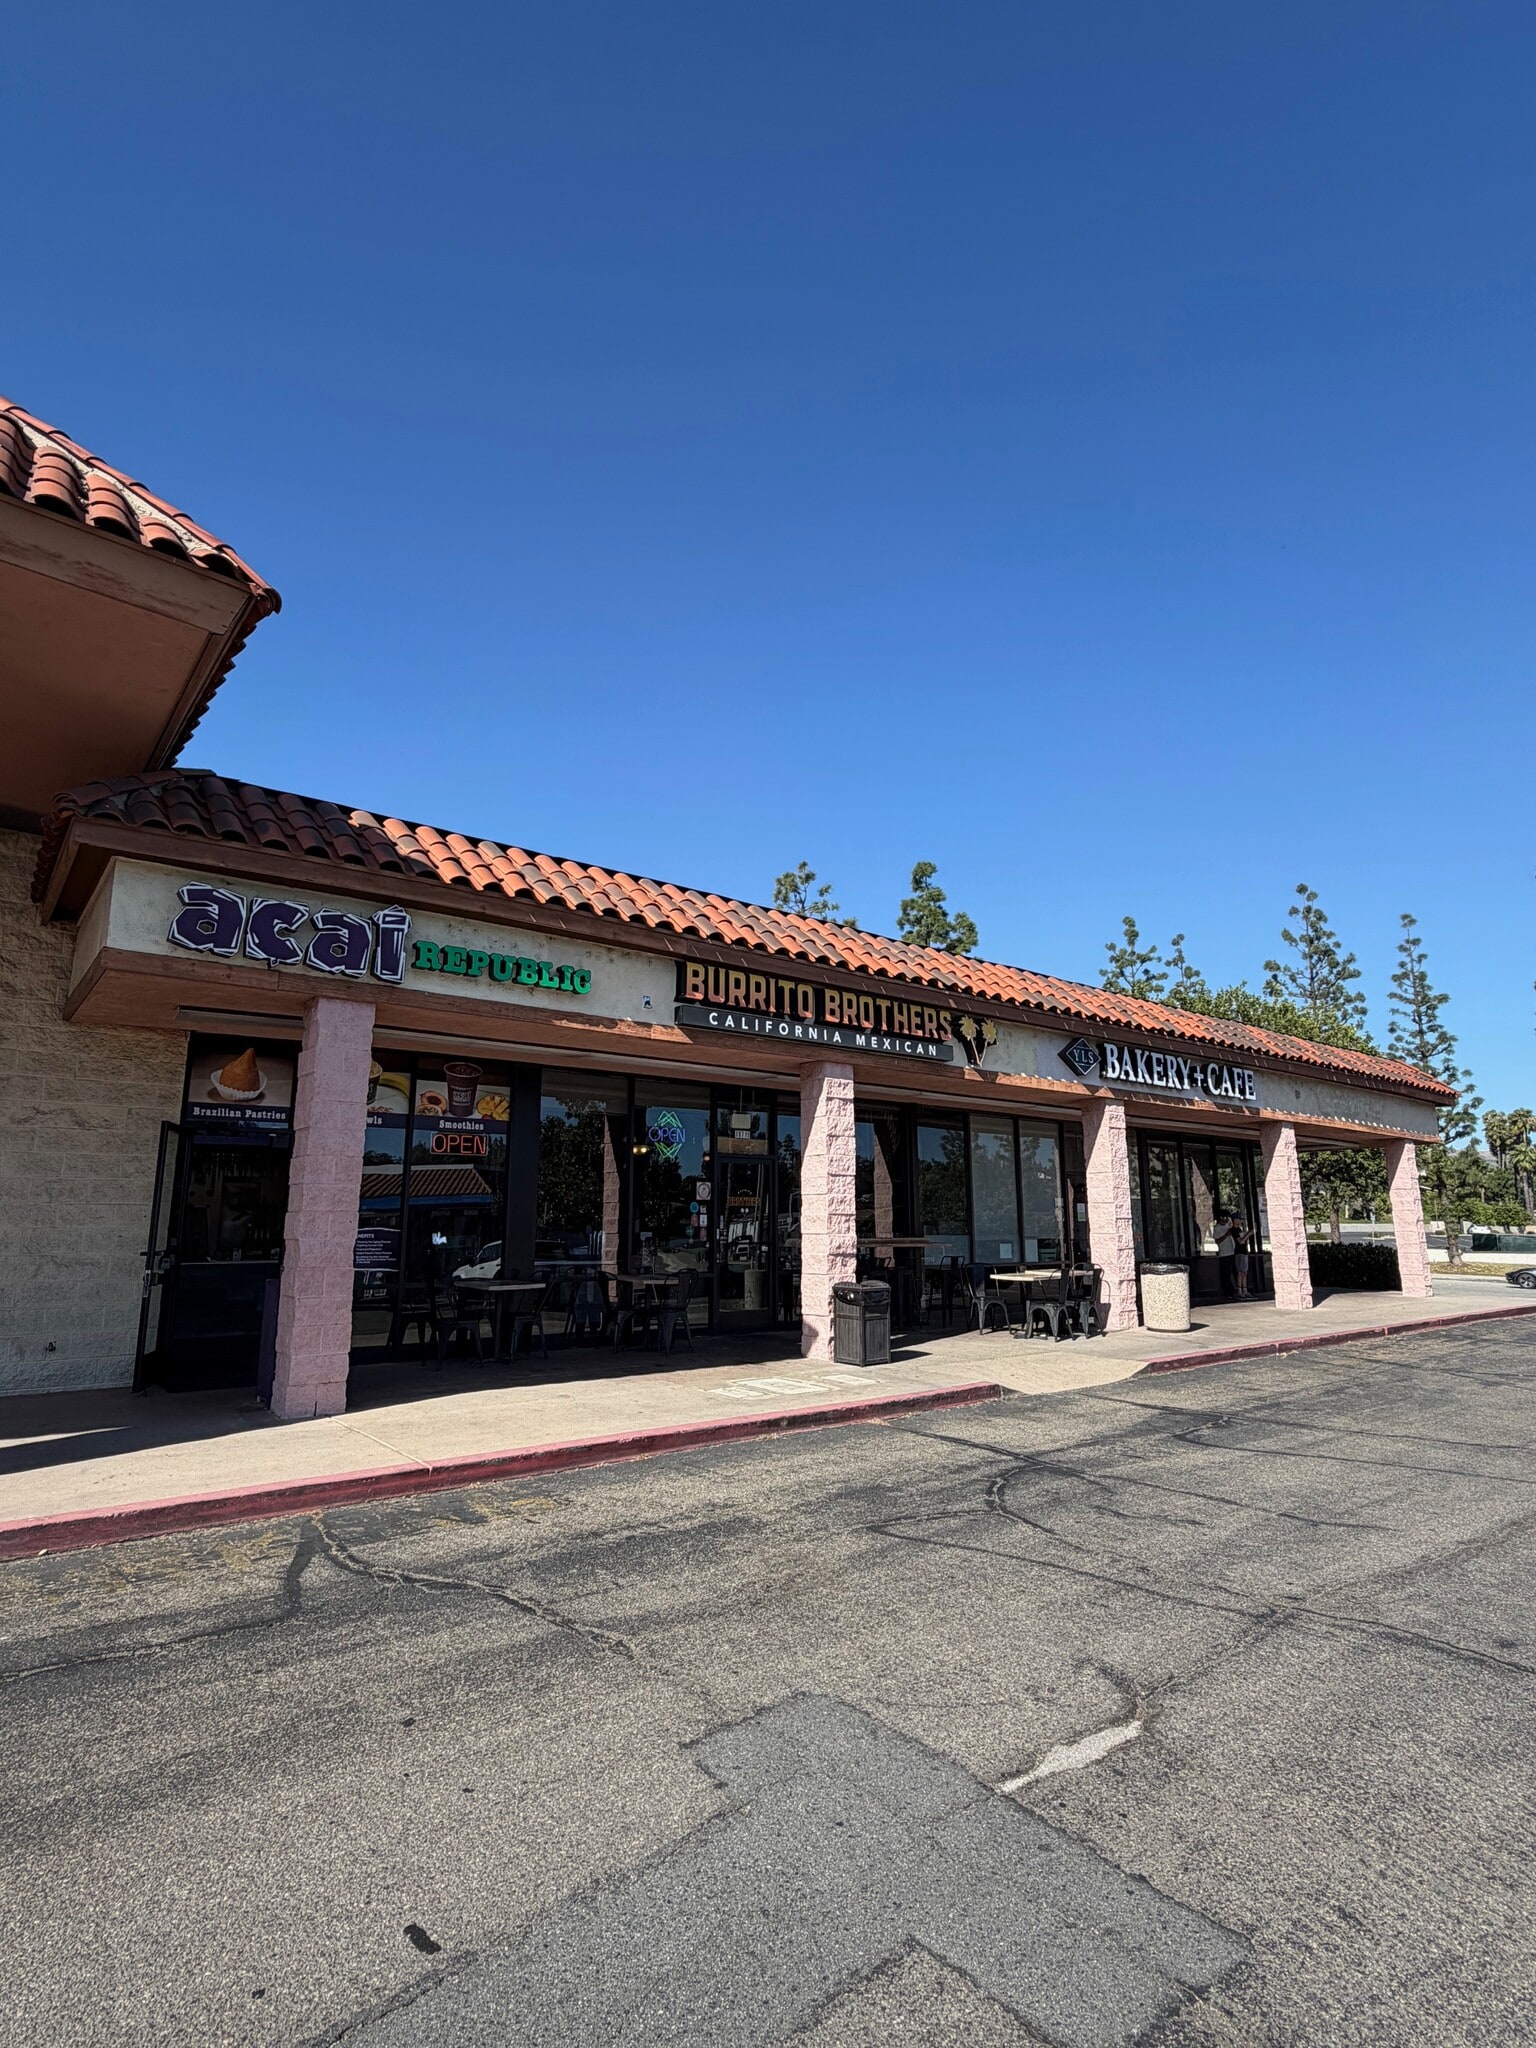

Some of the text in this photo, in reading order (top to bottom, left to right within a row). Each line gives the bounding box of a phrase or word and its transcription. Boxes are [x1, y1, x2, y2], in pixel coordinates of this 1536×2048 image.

[412, 939, 592, 995] REPUBLIC
[685, 961, 952, 1041] BURRITO BROTHERS
[708, 1011, 937, 1056] CALIFORNIA MEXICAN
[1073, 1048, 1095, 1064] YLS
[1103, 1043, 1191, 1090] BAKERY
[1206, 1063, 1257, 1100] CAFE
[193, 1106, 286, 1120] Brazilian Pastries
[439, 1119, 485, 1131] Smoothies
[648, 1126, 686, 1143] OPEN
[432, 1133, 488, 1155] OPEN
